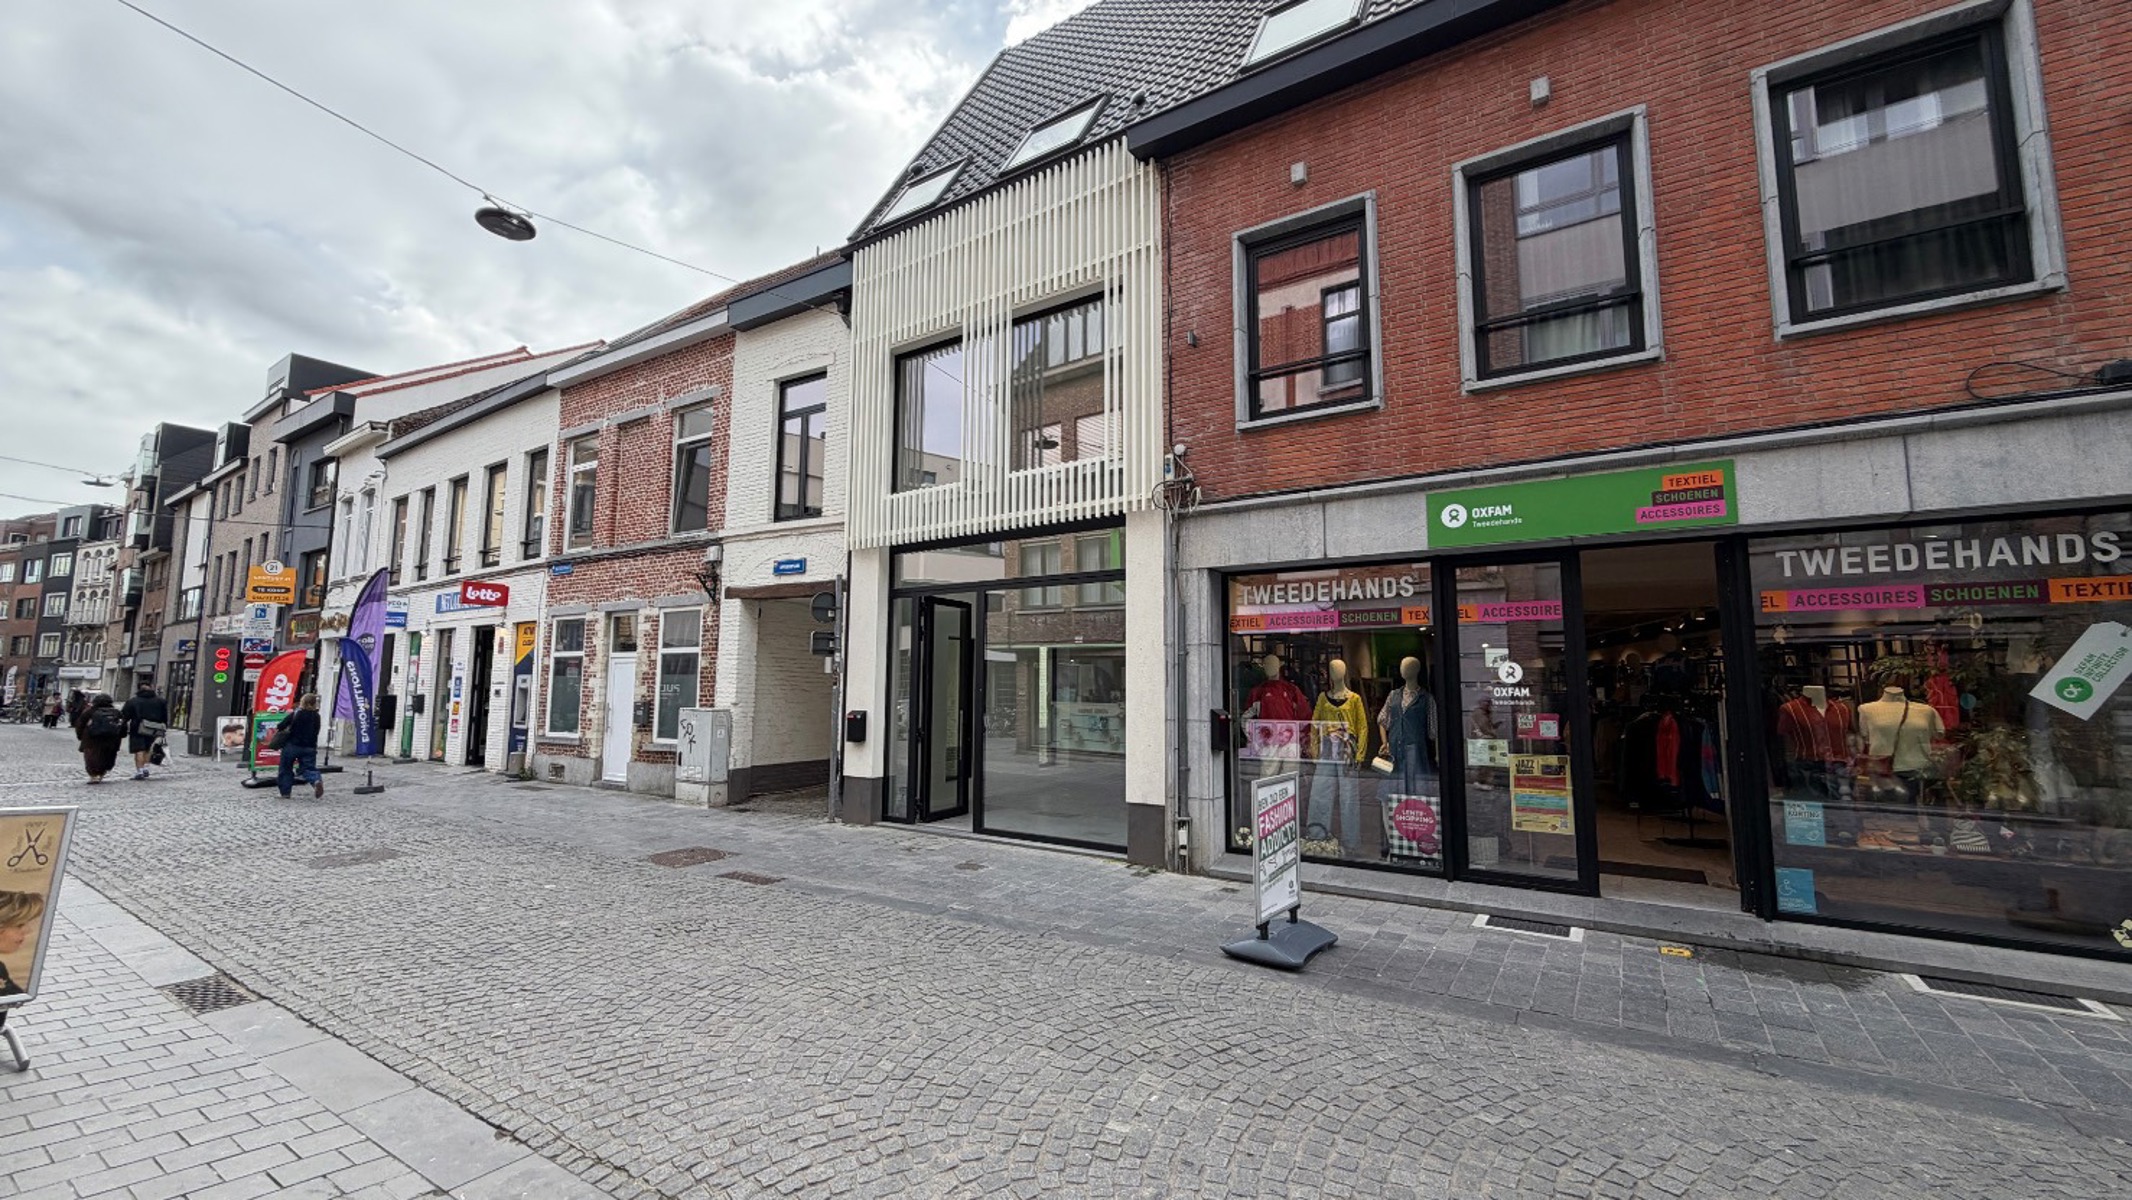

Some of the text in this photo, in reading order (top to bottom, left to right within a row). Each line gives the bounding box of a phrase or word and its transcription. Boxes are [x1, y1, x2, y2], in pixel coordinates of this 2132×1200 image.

[1667, 474, 1717, 488] TEXTIEL
[1655, 488, 1719, 504] SCHOENEN
[1471, 504, 1513, 518] OXFAM
[1639, 504, 1721, 521] ACCESSOIRES
[1471, 517, 1523, 528] Tweedehands
[1774, 531, 2122, 578] TWEEDEHANDS
[465, 586, 502, 601] Lotto
[1241, 576, 1415, 605] TWEEDEHANDS
[1794, 590, 1918, 607] ACCESSOIRES
[1930, 584, 2039, 602] SCHOENEN
[1269, 614, 1335, 627] ACCESSOIRES
[1341, 611, 1399, 623] SCHOENEN
[1493, 687, 1531, 698] OXFAM
[1515, 759, 1535, 769] JAZZ
[1258, 798, 1295, 838] FASHION
[1259, 820, 1296, 860] ADDICT?
